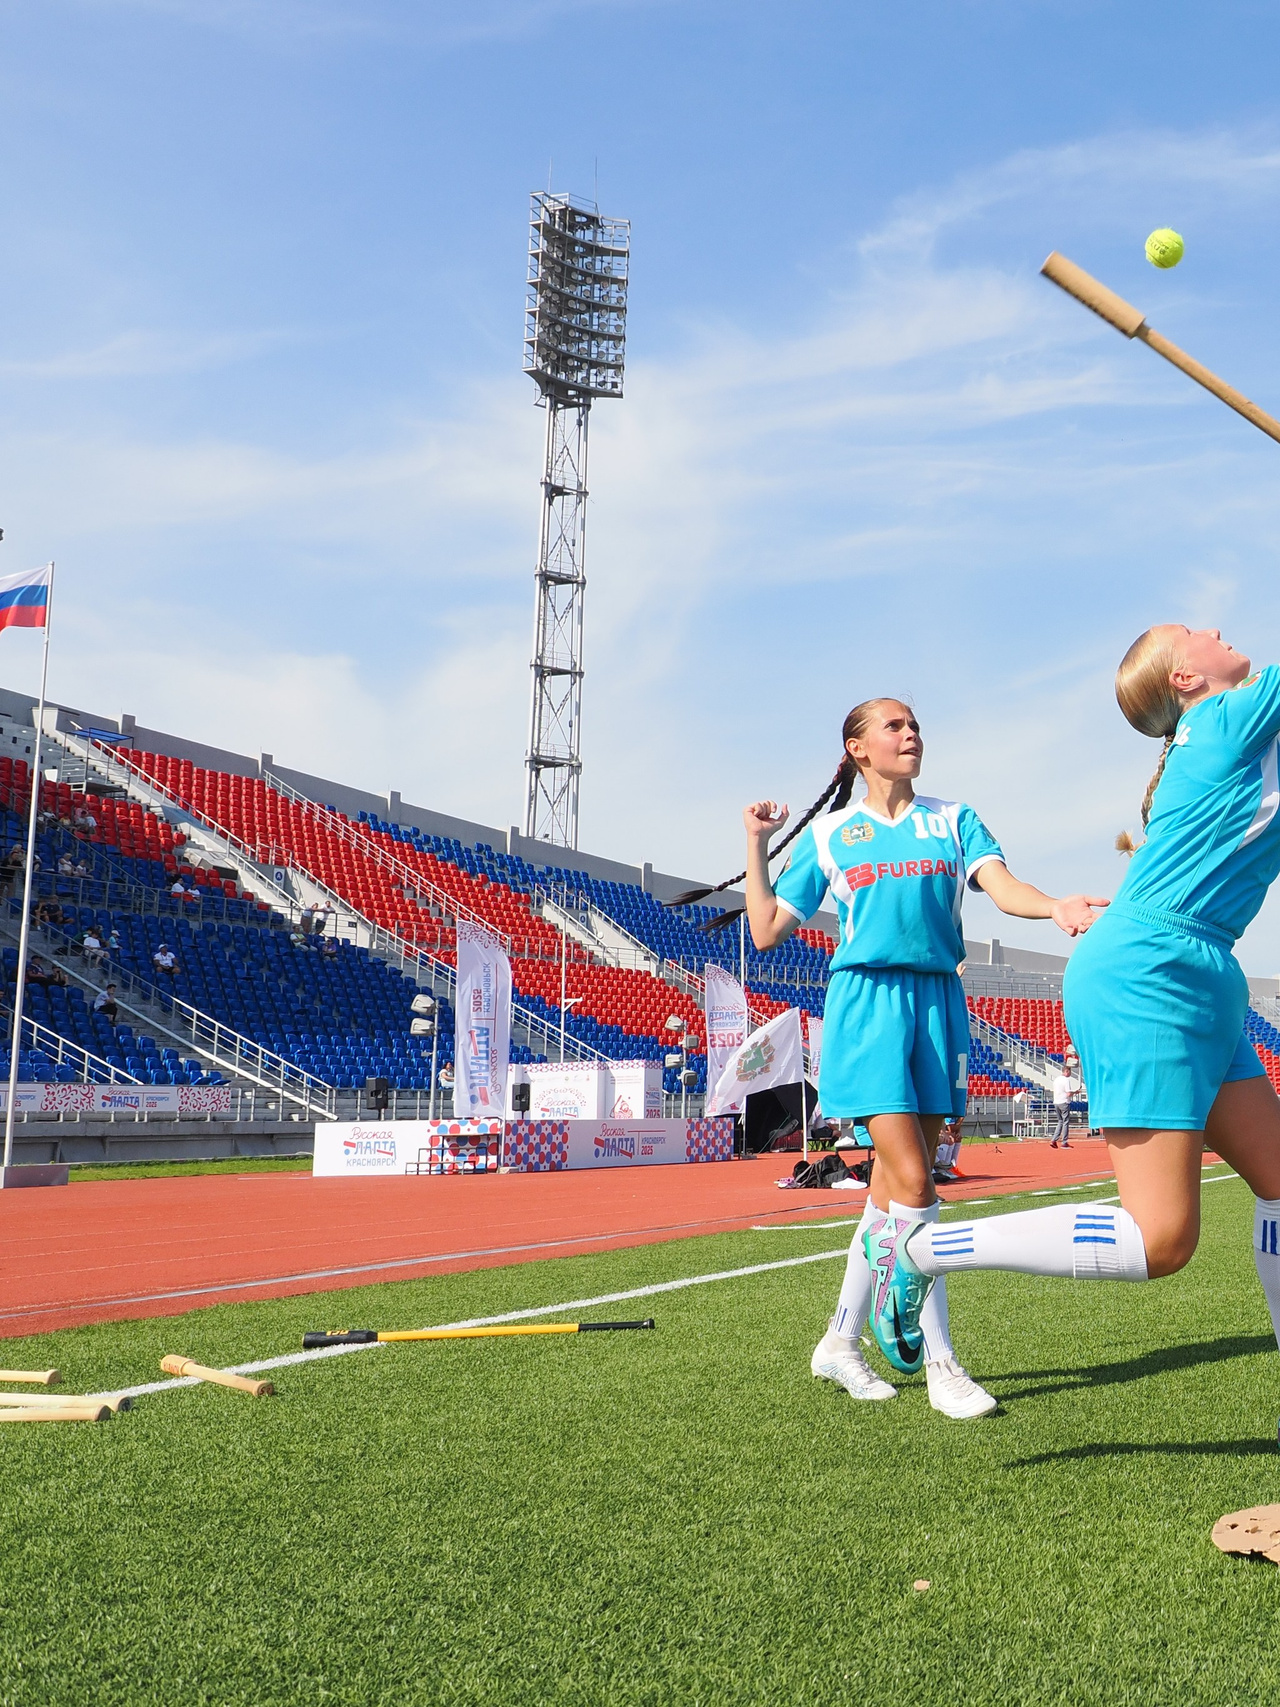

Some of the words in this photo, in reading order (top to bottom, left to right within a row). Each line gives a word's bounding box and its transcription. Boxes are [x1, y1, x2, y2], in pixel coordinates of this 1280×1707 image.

[910, 811, 949, 839] 10
[876, 858, 959, 880] FURBAU
[349, 1126, 395, 1140] Русская
[354, 1141, 397, 1160] ЛАПТА
[602, 1137, 636, 1157] ЛАПТА
[641, 1145, 654, 1156] 2025
[346, 1158, 397, 1167] КРАСНОЯРСК
